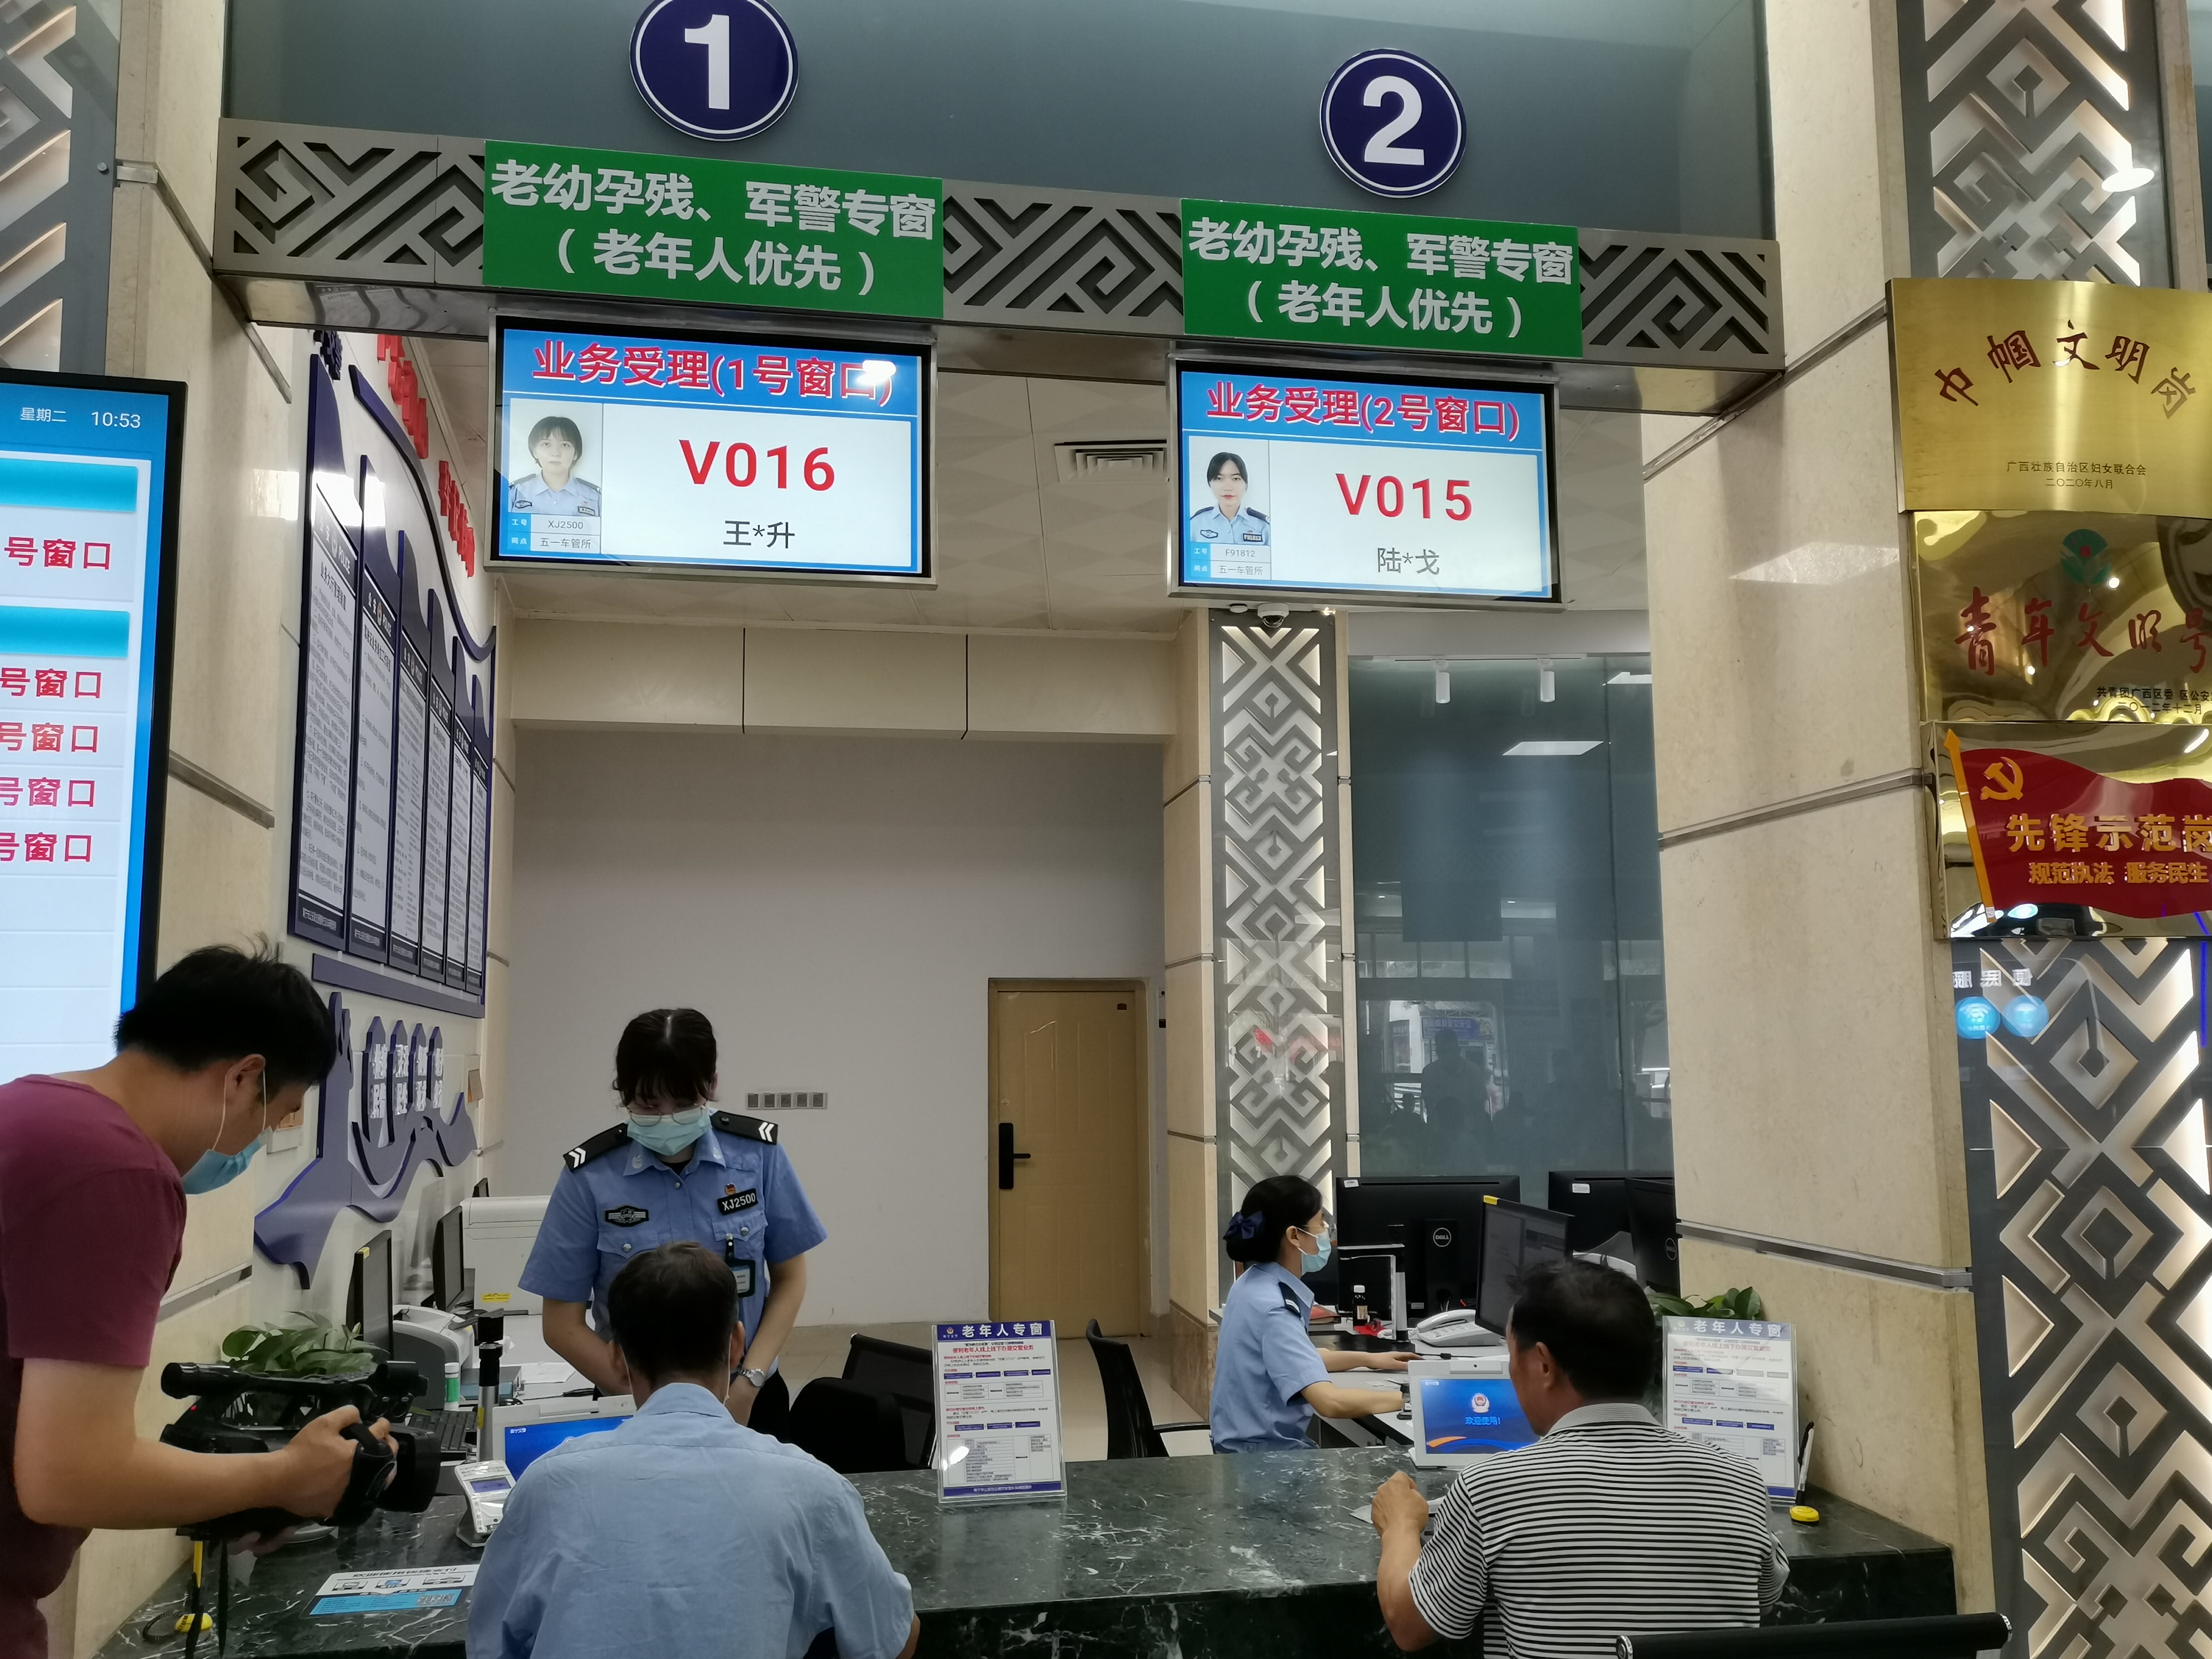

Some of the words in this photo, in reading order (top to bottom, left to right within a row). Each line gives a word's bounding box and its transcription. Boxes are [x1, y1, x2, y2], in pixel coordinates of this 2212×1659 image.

[685, 14, 730, 110] 1
[1363, 76, 1425, 166] 2
[491, 159, 936, 240] 老幼孕残、军警专窗
[1188, 217, 1573, 285] 老幼孕残、军警专窗
[1934, 320, 2196, 419] 巾帼文明岗
[20, 407, 67, 422] 星期二
[91, 411, 141, 428] 10:53
[1206, 380, 1520, 442] 业务受理(2号窗口)
[678, 439, 836, 491] V016
[2006, 461, 2147, 476] 广西壮族自治区妇女联合会
[1335, 473, 1472, 521] V015
[547, 520, 583, 529] XJ2500
[4, 536, 111, 570] 号窗口
[540, 537, 592, 550] 五一车管所
[1225, 549, 1256, 557] F91812
[1218, 565, 1263, 576] 五一车管所
[1954, 586, 2212, 676] 青年文明号
[0, 667, 102, 699] 号窗口
[2096, 686, 2173, 700] 共青团广西区委
[2179, 690, 2212, 702] 区公安
[0, 722, 98, 753] 号窗口
[0, 777, 95, 807] 号窗口
[2006, 813, 2212, 853] 先锋示范岗
[2028, 861, 2115, 885] 规范执法
[2124, 860, 2210, 884] 服务民生
[722, 1192, 757, 1211] XJ2500
[962, 1322, 1042, 1338] 老年人专窗
[1693, 1319, 1781, 1338] 老年人专窗
